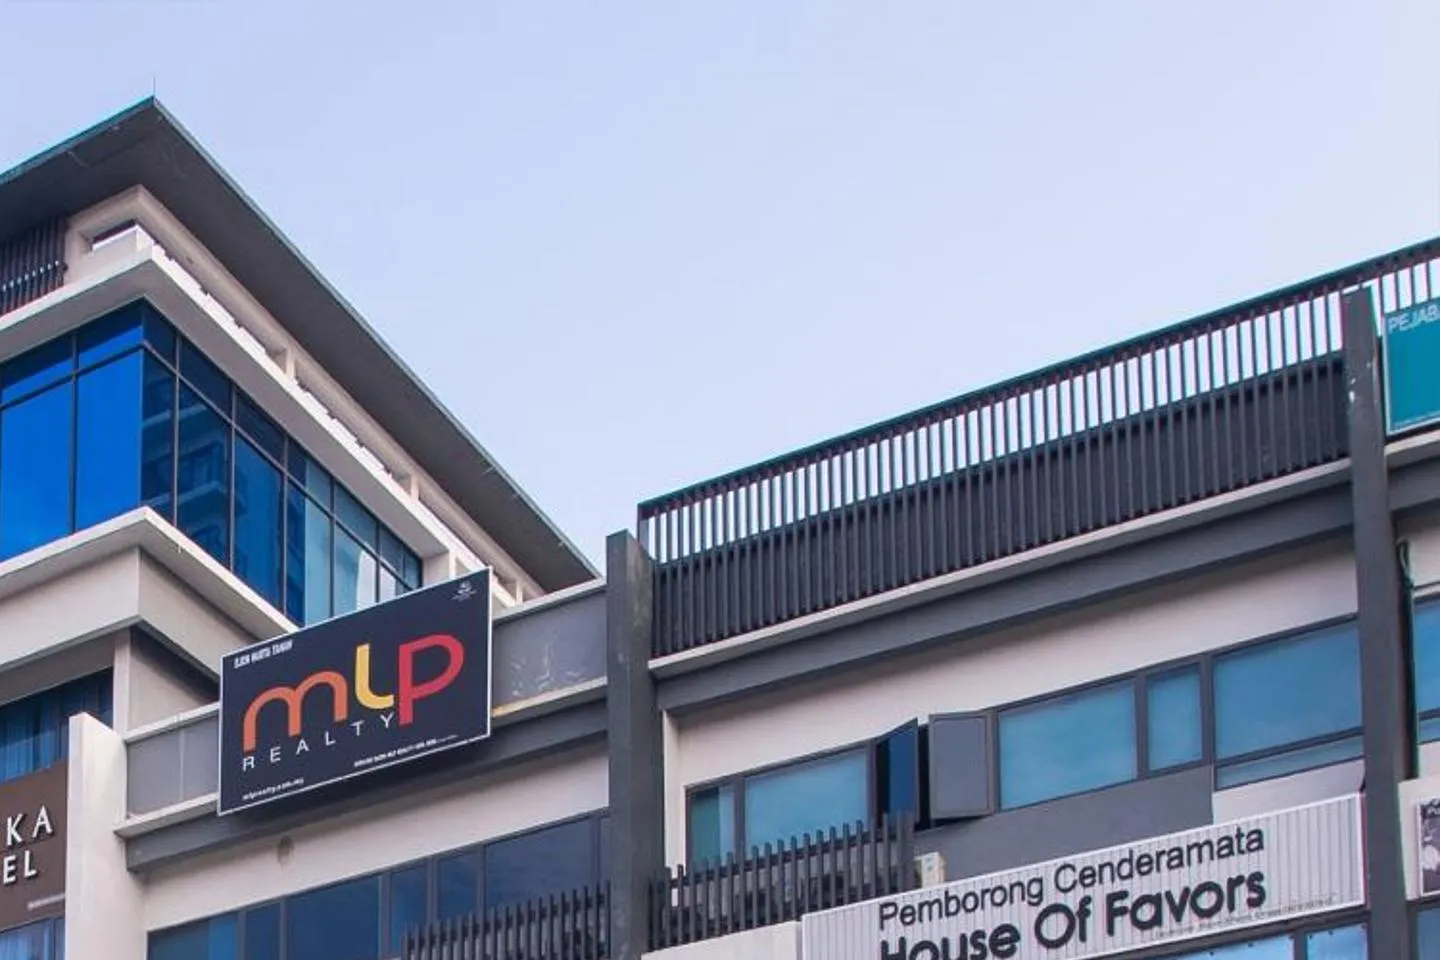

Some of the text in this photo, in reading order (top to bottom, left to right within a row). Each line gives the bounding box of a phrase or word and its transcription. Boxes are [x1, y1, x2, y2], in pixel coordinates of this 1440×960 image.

[243, 712, 394, 772] REALTY
[880, 828, 1264, 932] Pemborong Cenderamata
[1034, 894, 1091, 951] Of
[1106, 869, 1266, 935] Favors
